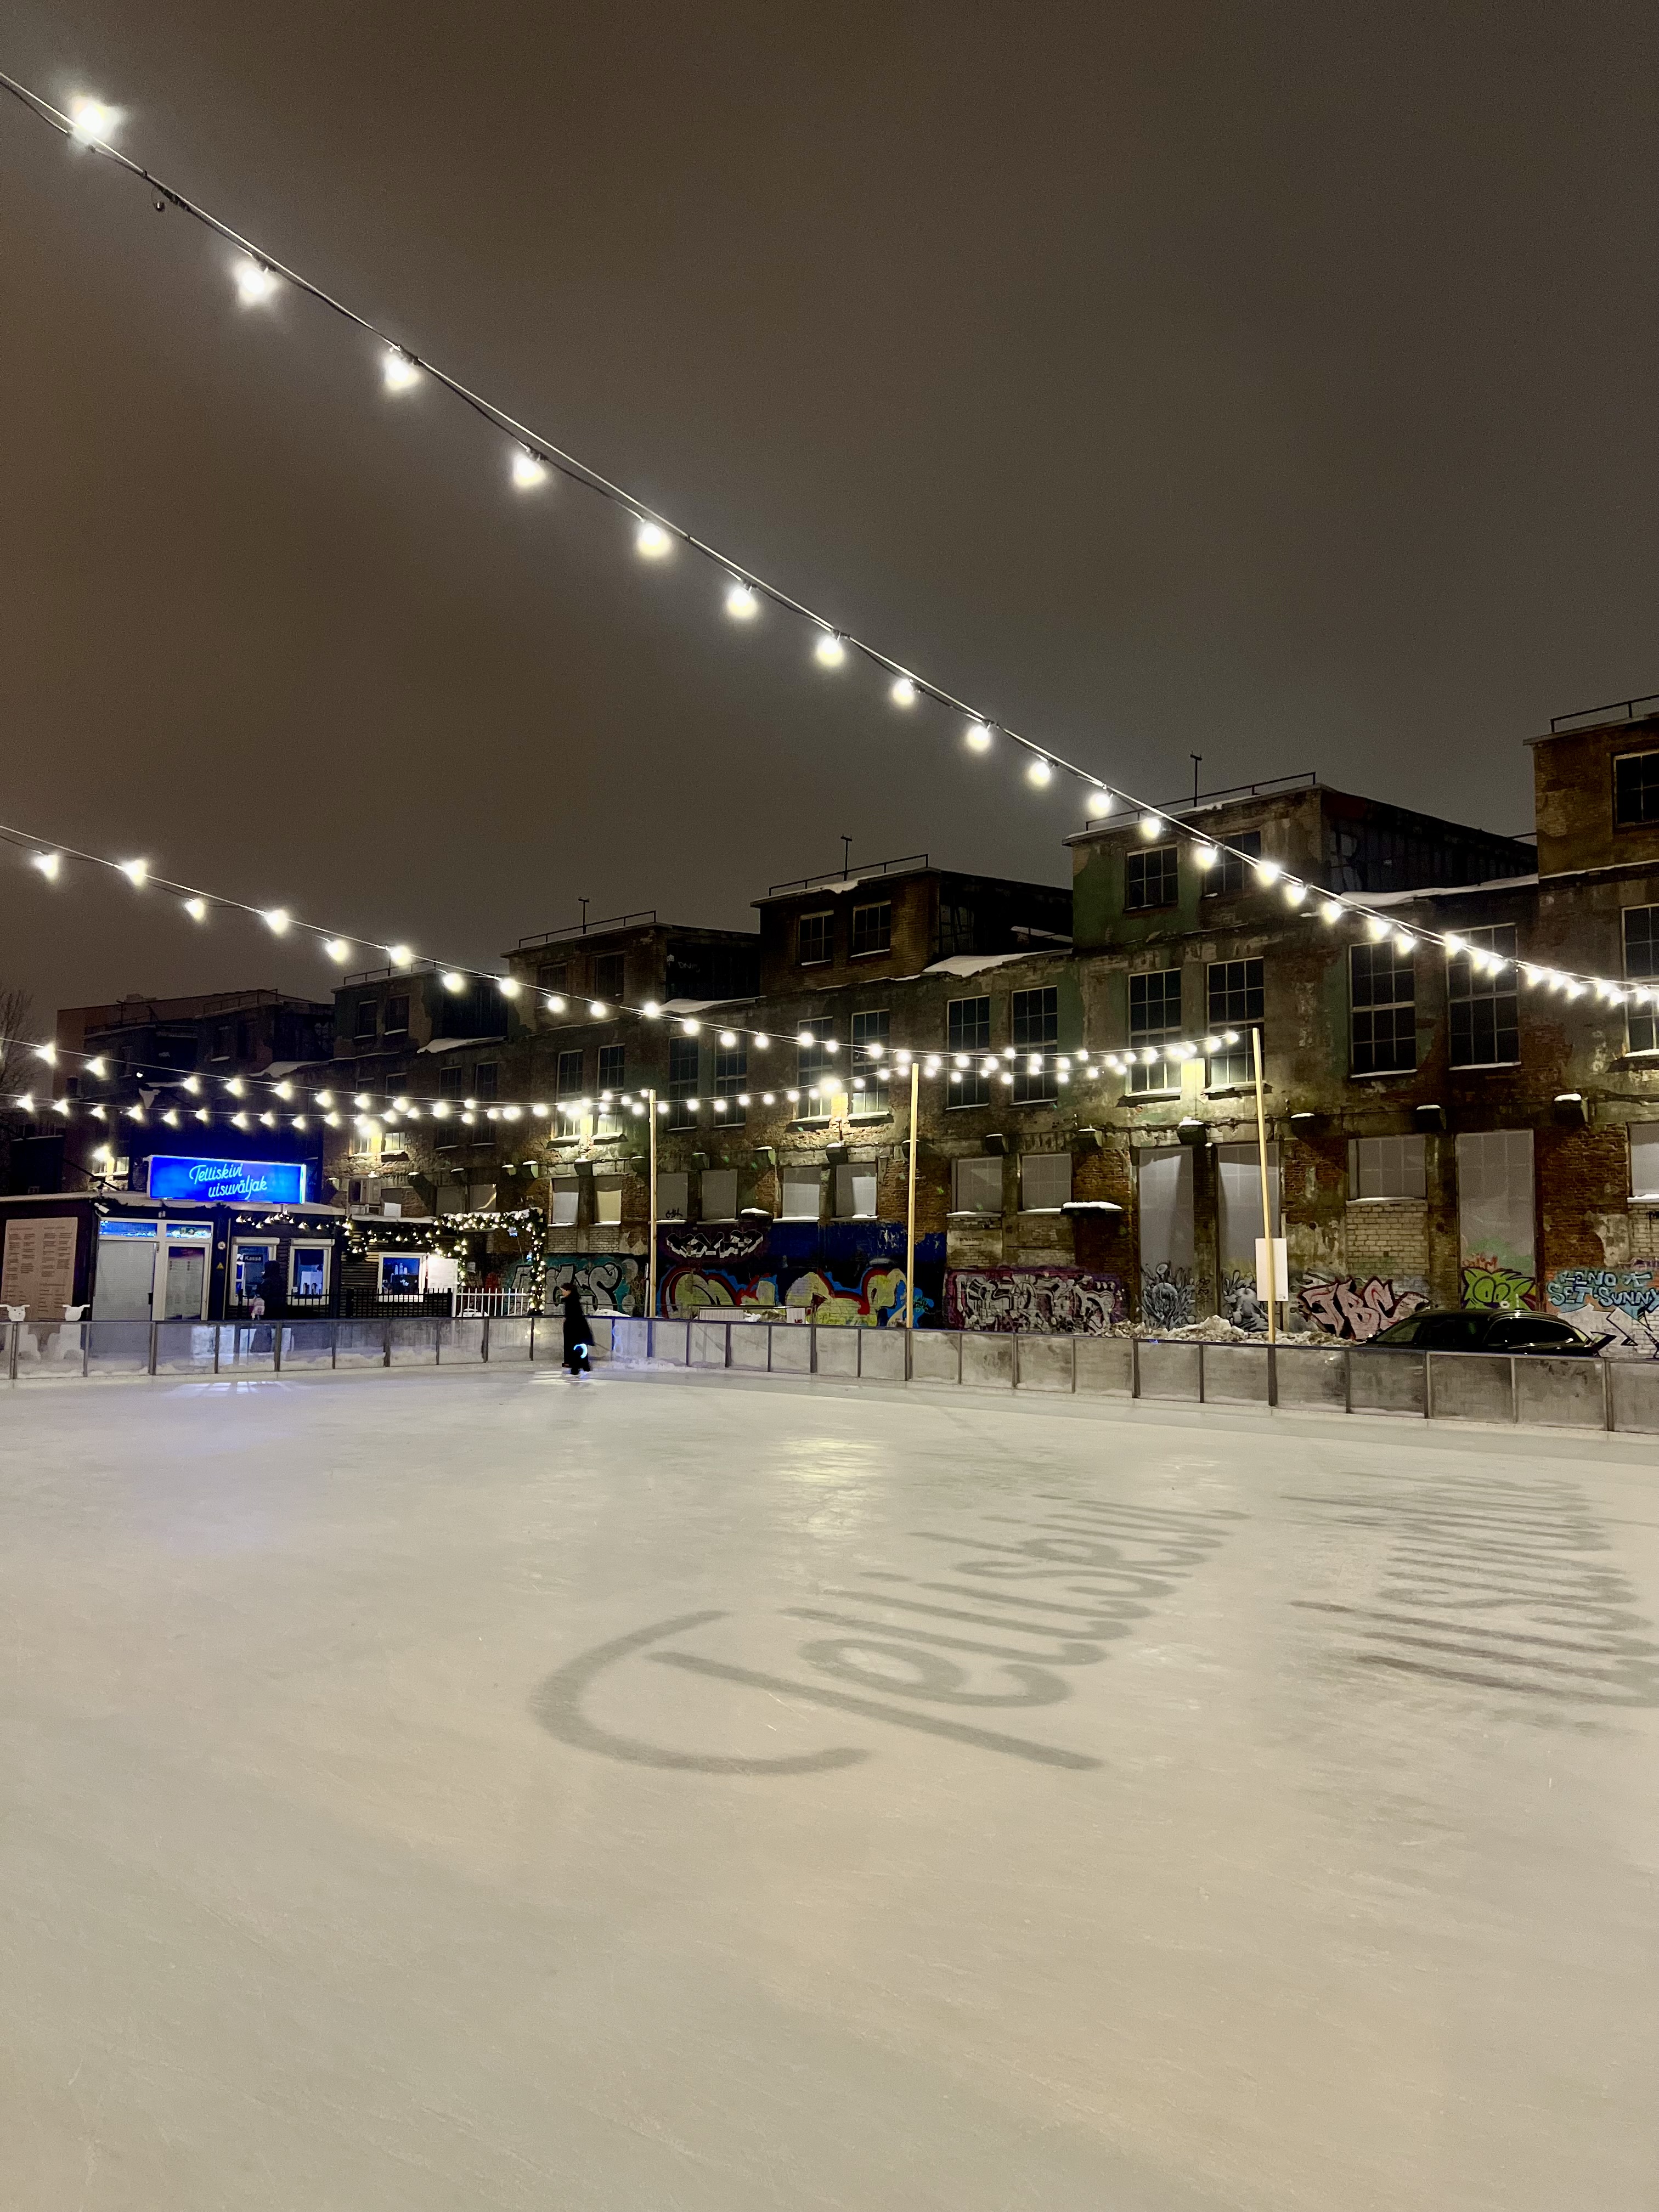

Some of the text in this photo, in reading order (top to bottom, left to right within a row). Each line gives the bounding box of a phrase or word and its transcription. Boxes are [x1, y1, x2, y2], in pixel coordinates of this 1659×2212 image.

[189, 1163, 243, 1185] Telliskivi
[208, 1175, 268, 1200] uisuväljak
[528, 1493, 1252, 1774] Telliskivi
